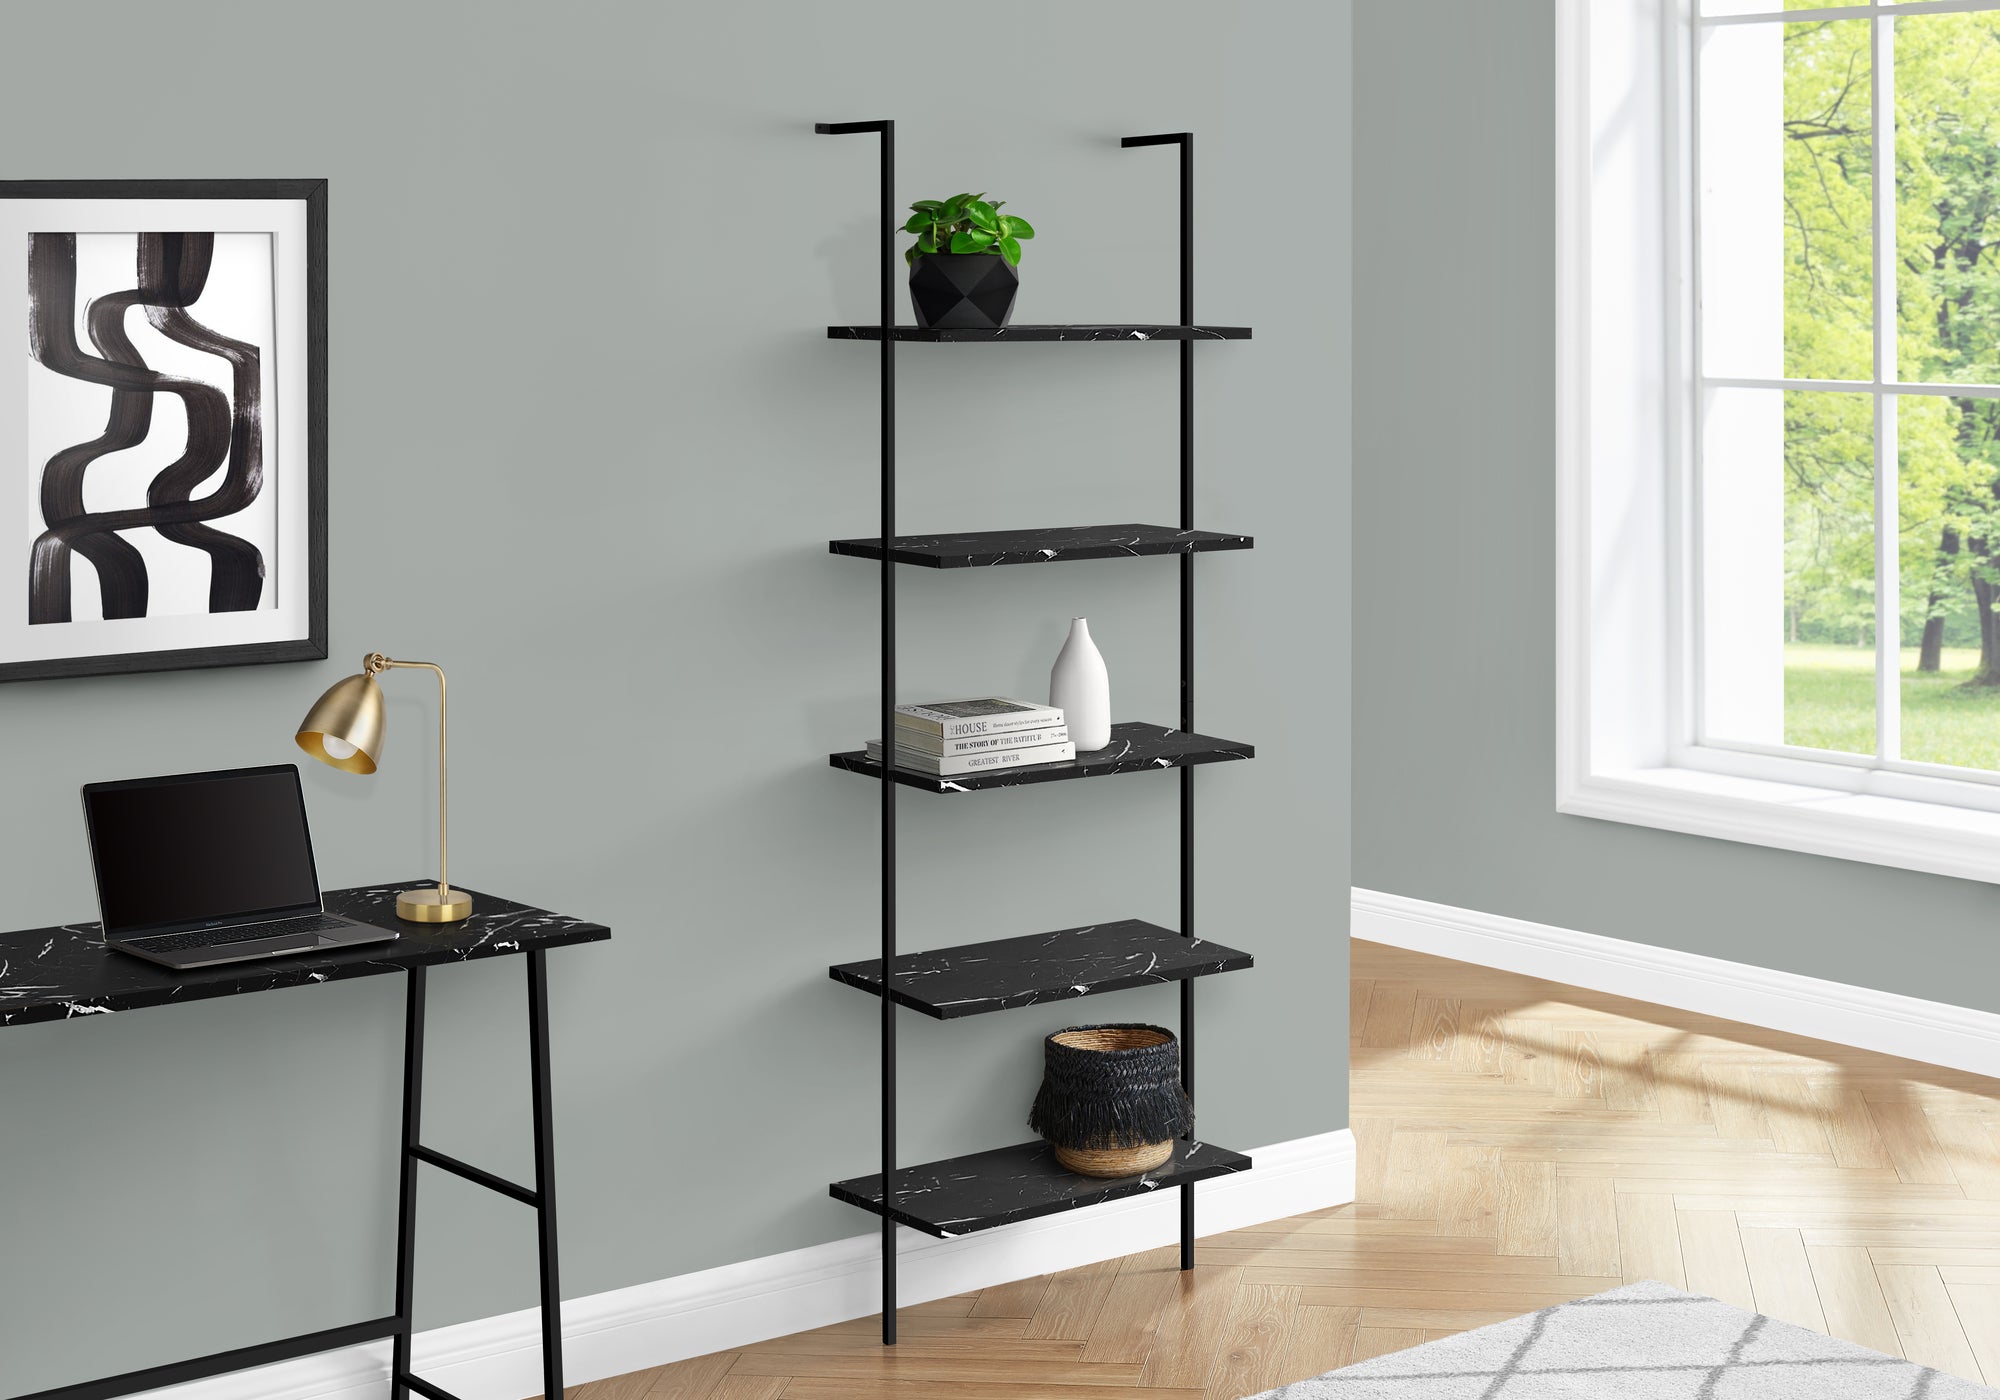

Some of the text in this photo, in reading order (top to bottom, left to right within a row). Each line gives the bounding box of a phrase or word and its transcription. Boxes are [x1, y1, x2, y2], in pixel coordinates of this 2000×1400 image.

[955, 721, 987, 735] HOUSE
[955, 742, 968, 750] THE
[968, 740, 989, 749] STORY
[1000, 737, 1013, 745] THE
[968, 754, 1020, 767] GREATEST RIVER
